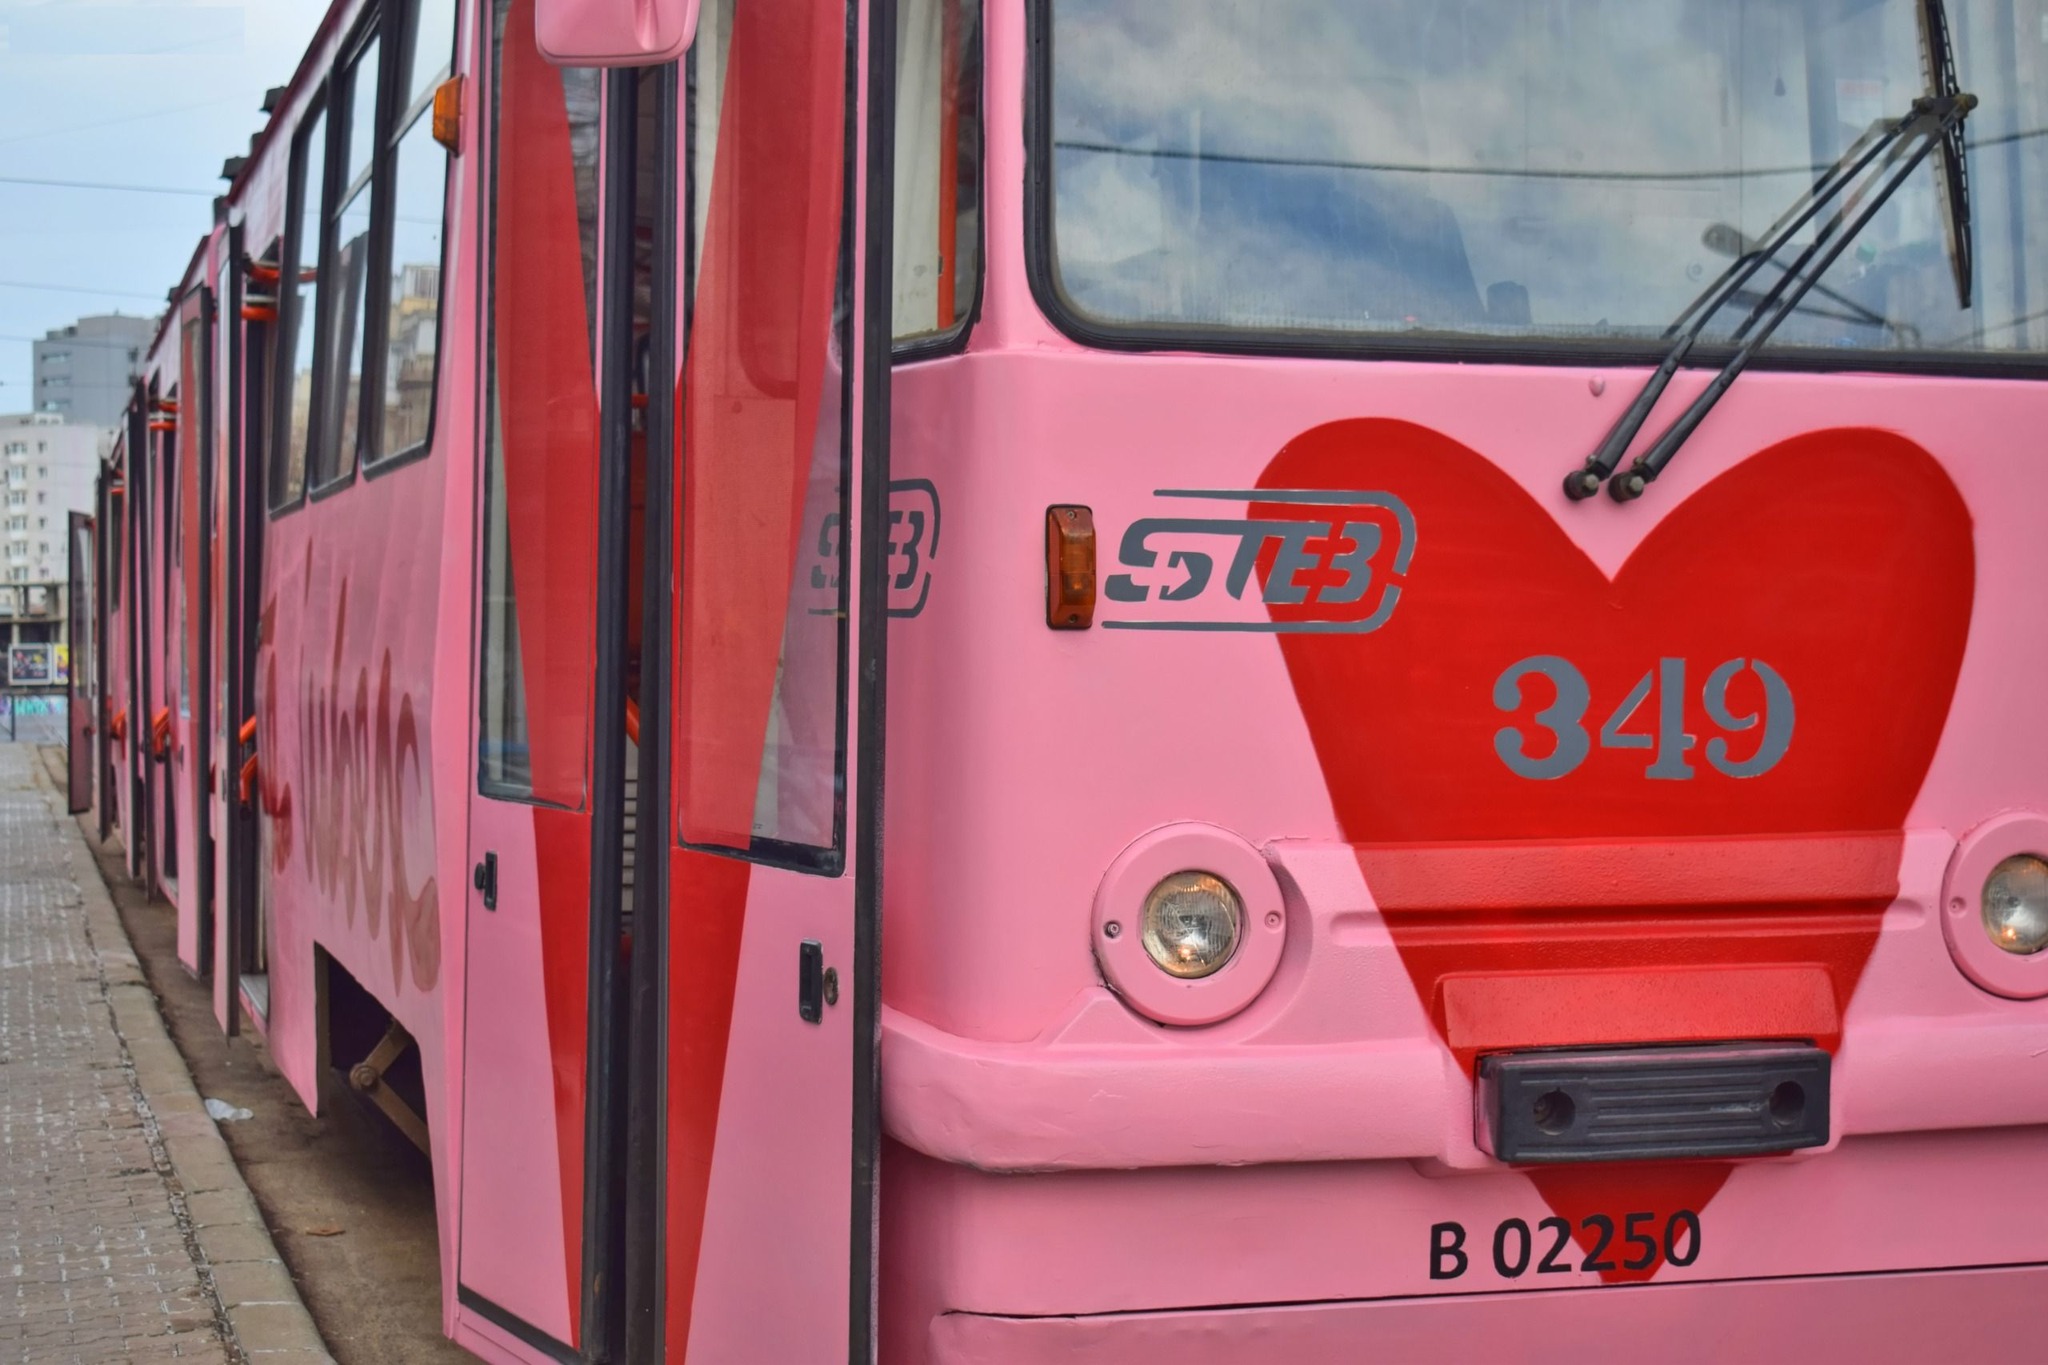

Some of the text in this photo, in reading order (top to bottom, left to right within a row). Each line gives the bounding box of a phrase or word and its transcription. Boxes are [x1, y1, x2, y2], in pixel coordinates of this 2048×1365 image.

[1493, 655, 1796, 780] 349
[1429, 1208, 1702, 1280] B 02250
